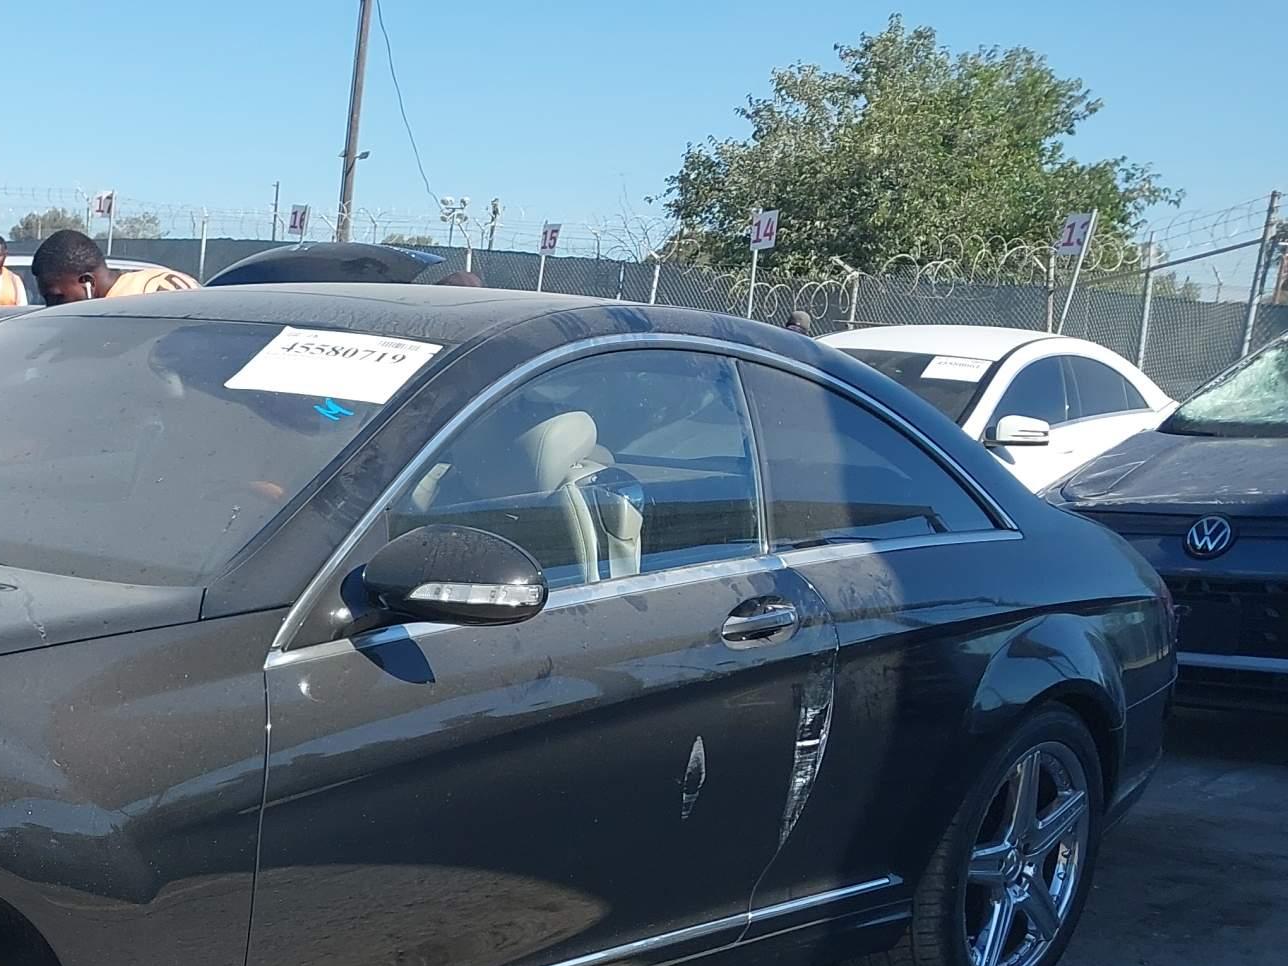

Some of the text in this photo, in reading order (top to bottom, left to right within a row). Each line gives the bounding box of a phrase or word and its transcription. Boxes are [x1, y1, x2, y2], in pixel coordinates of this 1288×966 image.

[95, 195, 113, 214] 17
[541, 229, 559, 249] 15
[752, 218, 775, 244] 14
[281, 341, 407, 364] 45580719
